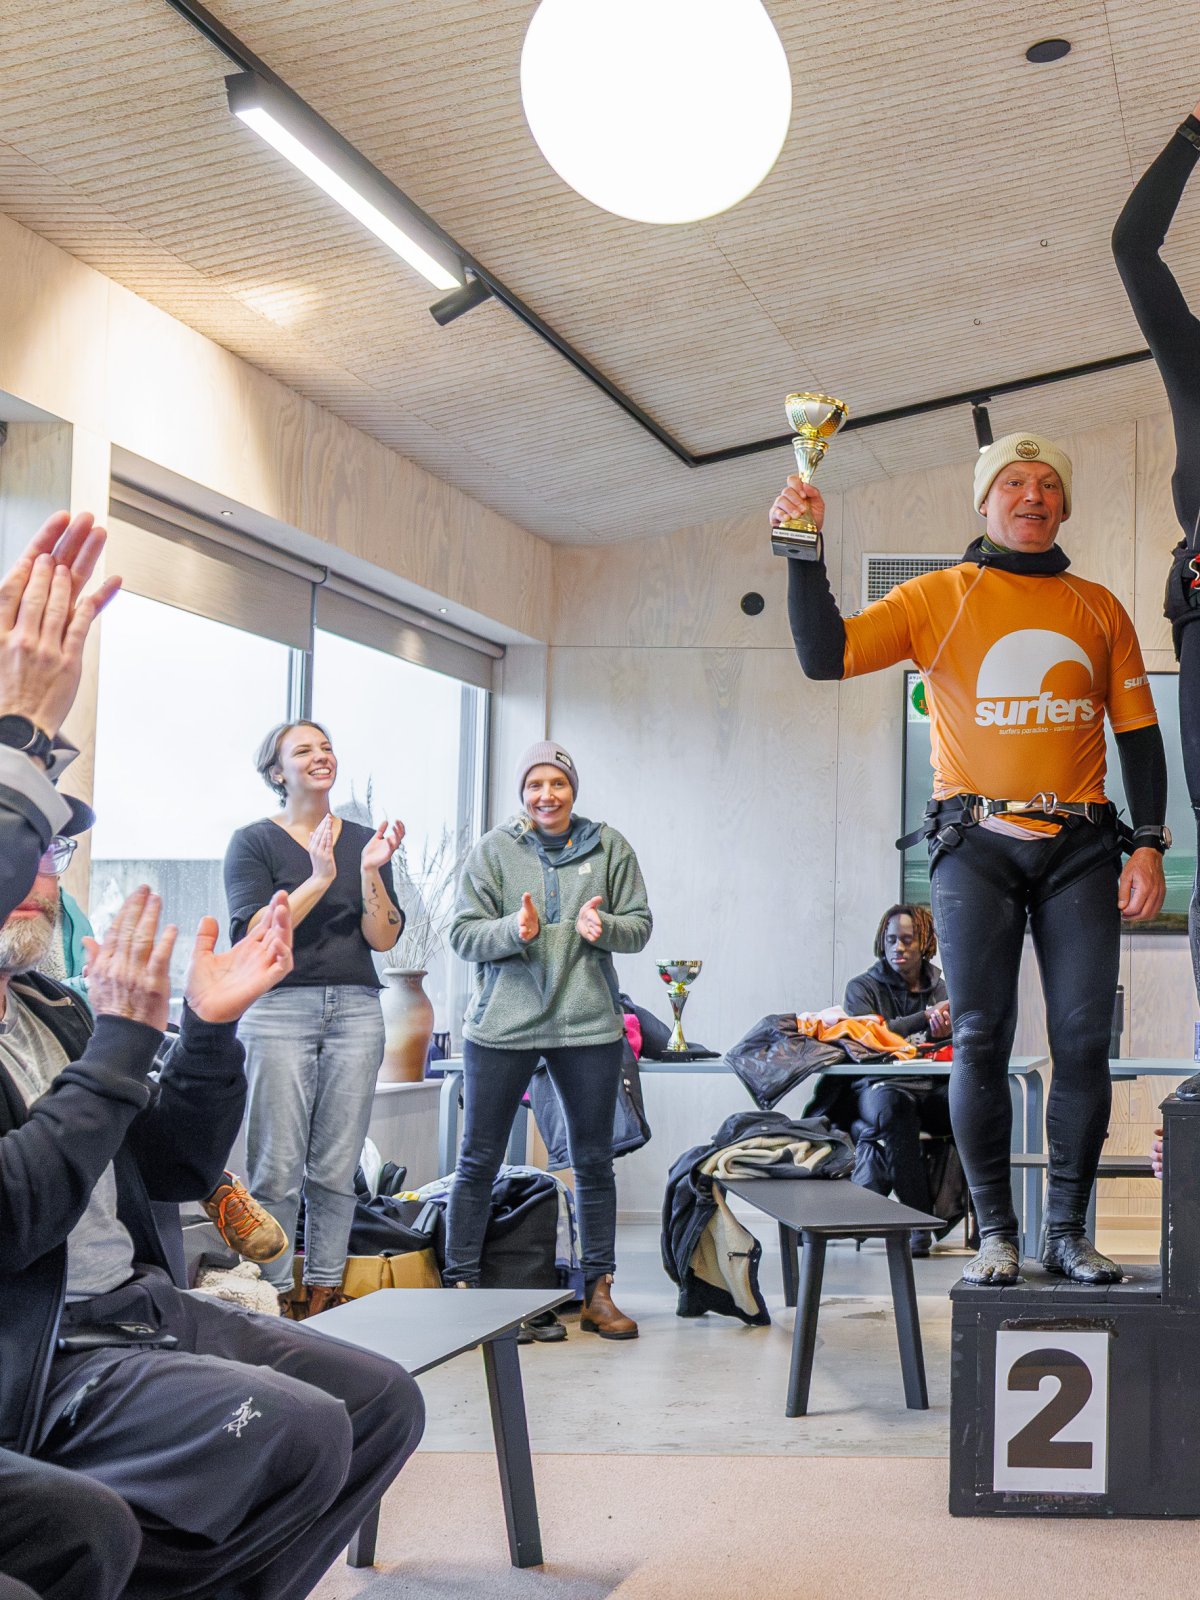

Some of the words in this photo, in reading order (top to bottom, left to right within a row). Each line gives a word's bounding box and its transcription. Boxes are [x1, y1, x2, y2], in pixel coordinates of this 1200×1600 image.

[974, 691, 1095, 727] surfers
[1021, 727, 1048, 735] paradise
[1007, 1348, 1094, 1470] 2
